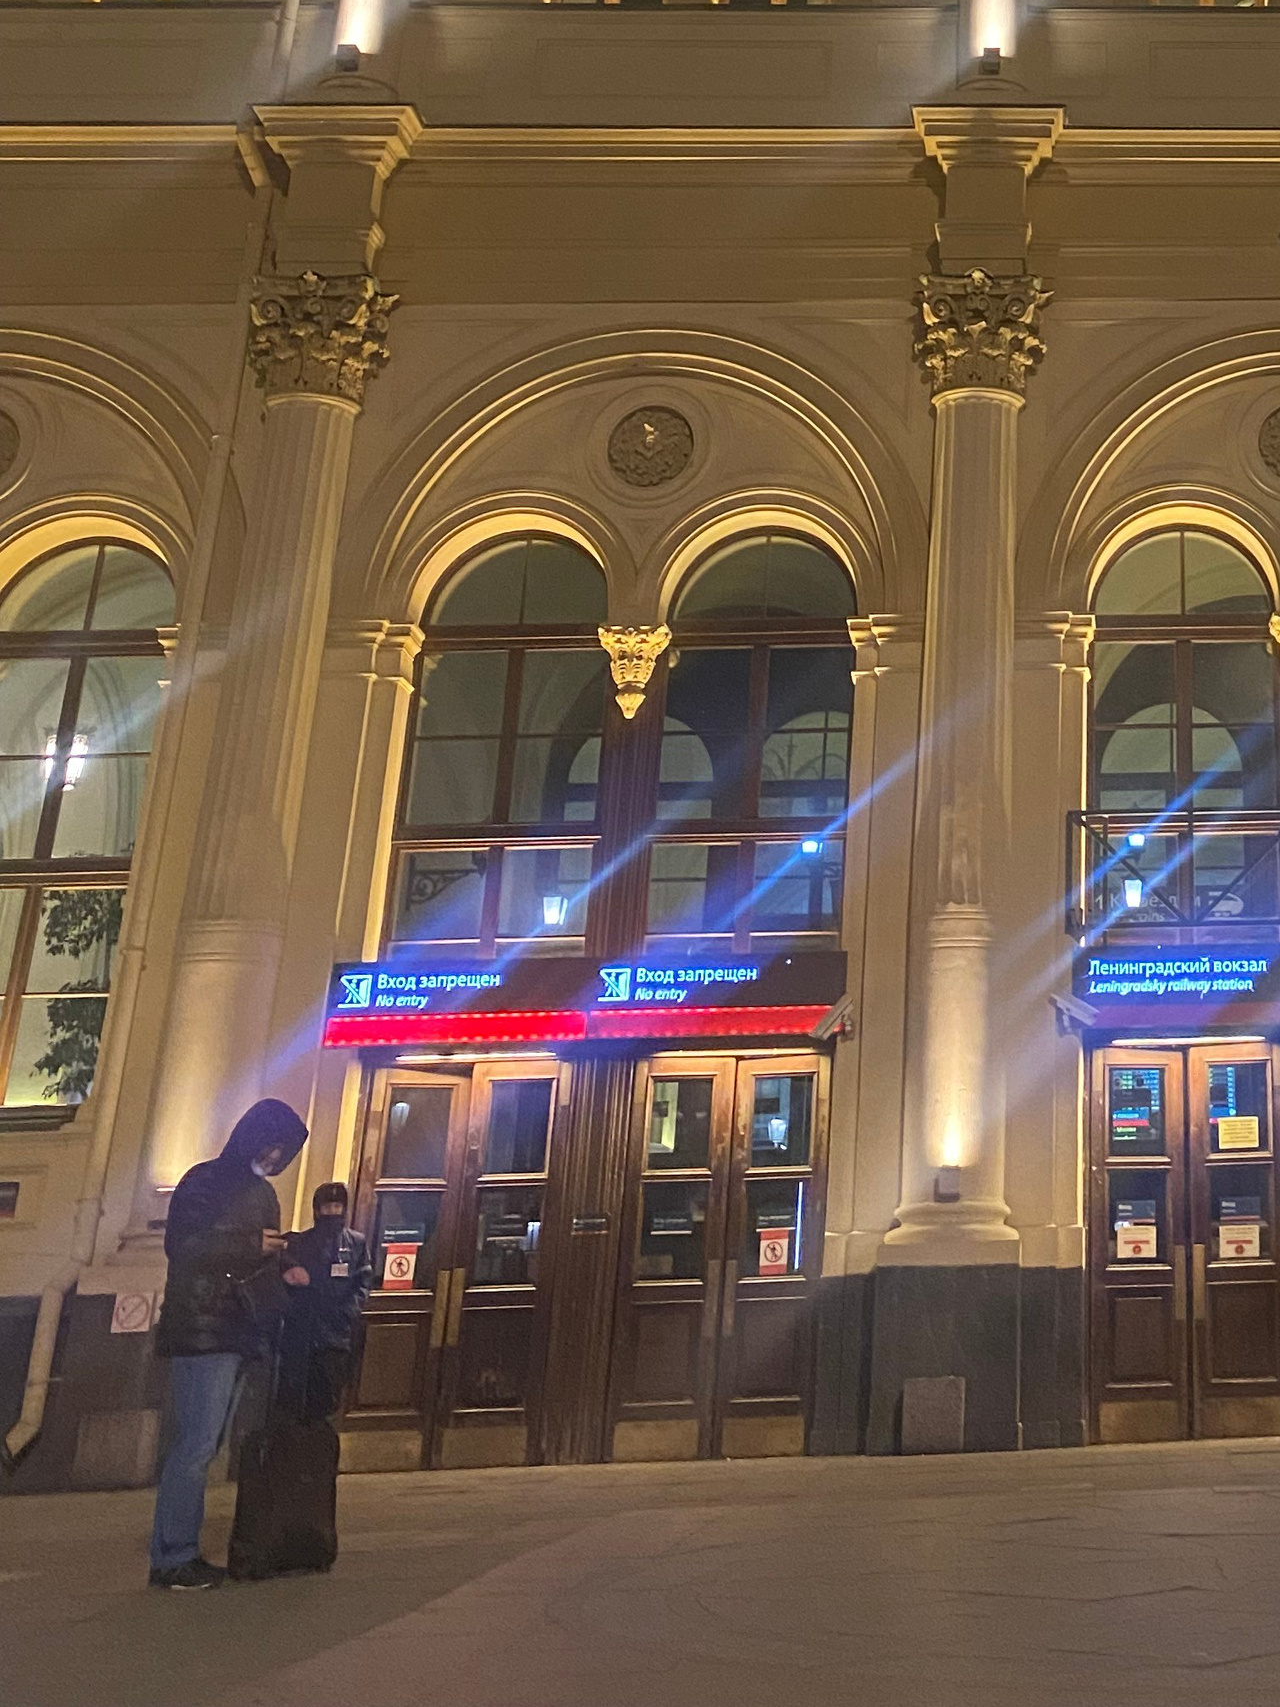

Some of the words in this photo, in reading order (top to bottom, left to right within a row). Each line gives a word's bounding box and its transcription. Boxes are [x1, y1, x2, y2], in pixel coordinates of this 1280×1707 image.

[636, 967, 675, 984] Вход
[677, 968, 758, 985] запрещен
[1088, 956, 1211, 978] Ленинградский
[1213, 959, 1268, 972] вокзал
[377, 973, 417, 991] Вход
[419, 974, 500, 991] запрещен
[1090, 980, 1167, 995] Leningradsky
[1168, 978, 1212, 994] railway
[1212, 977, 1254, 991] station
[375, 994, 394, 1007] No
[396, 995, 429, 1010] entry
[634, 988, 654, 1001] No
[655, 988, 688, 1003] entry
